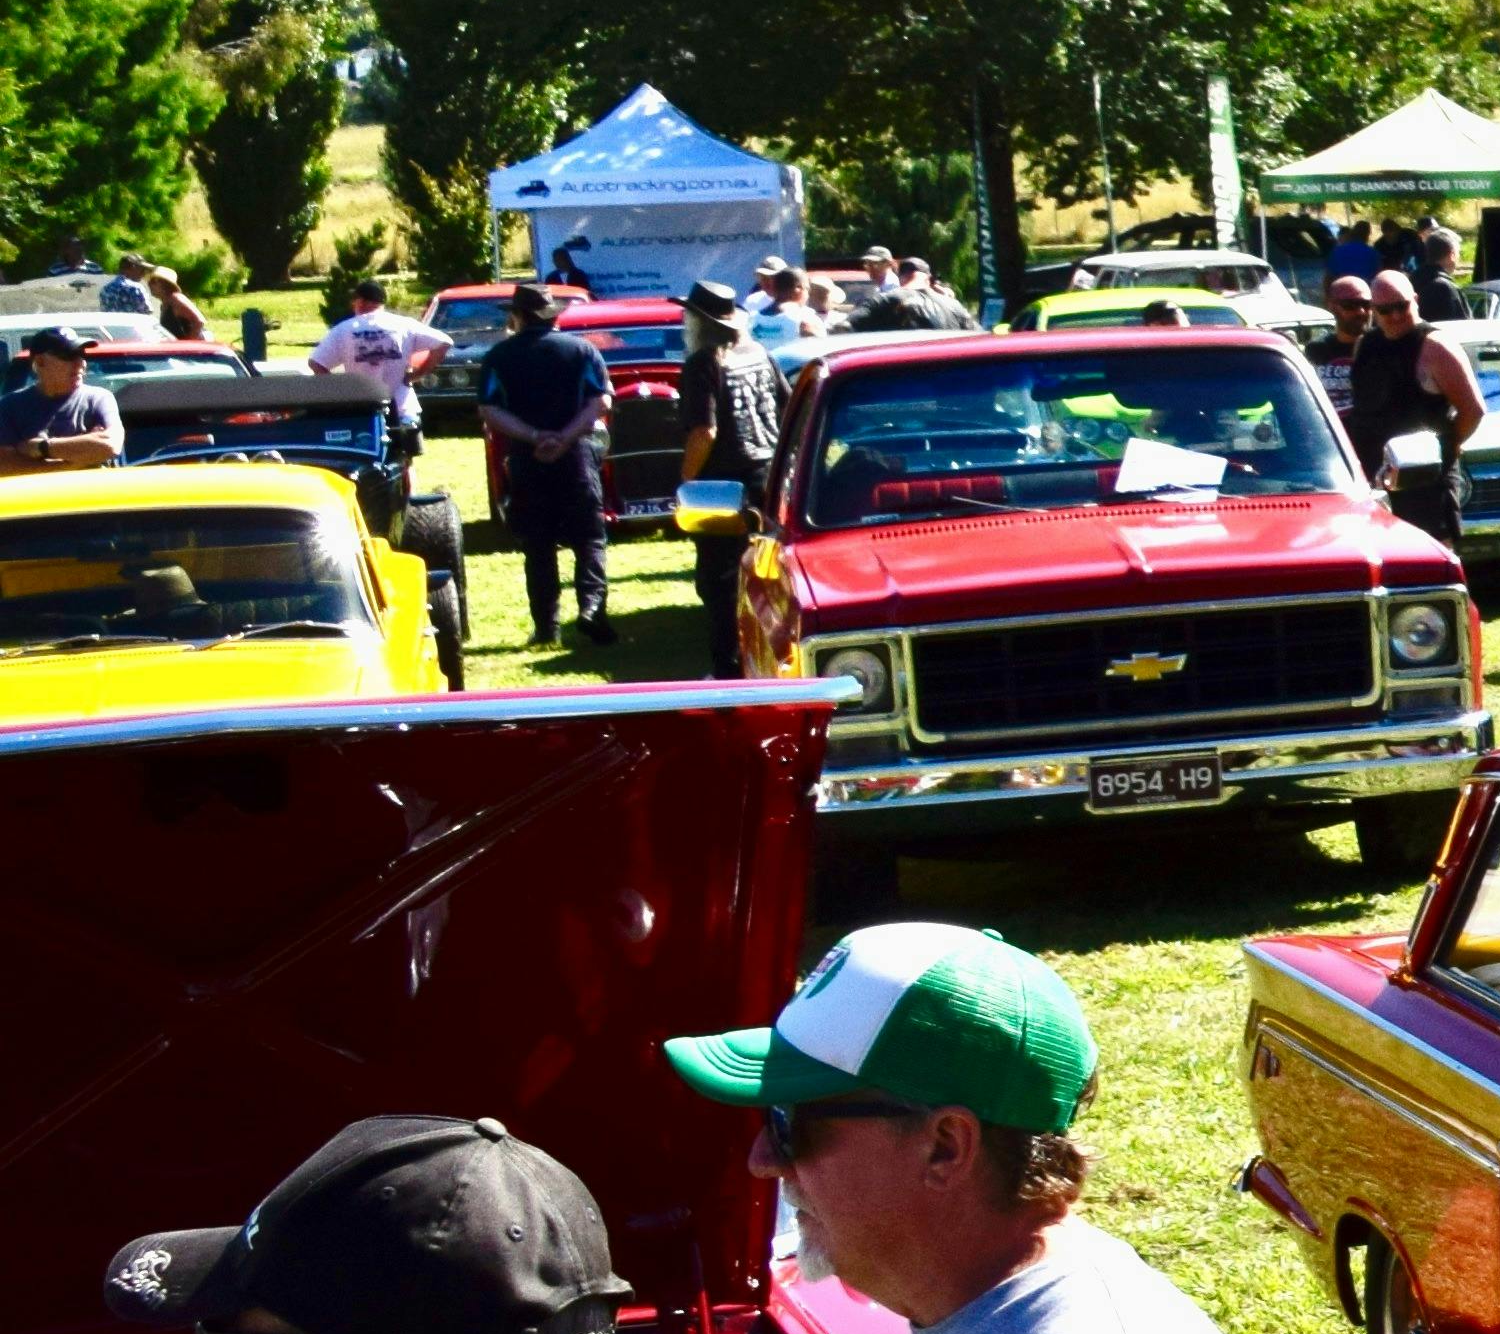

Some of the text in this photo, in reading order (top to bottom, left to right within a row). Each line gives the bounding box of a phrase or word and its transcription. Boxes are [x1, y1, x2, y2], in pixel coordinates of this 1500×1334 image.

[560, 177, 758, 194] Autotracking.com.au
[1293, 178, 1491, 195] JOIN THE SHANNONS CLUB TODAY
